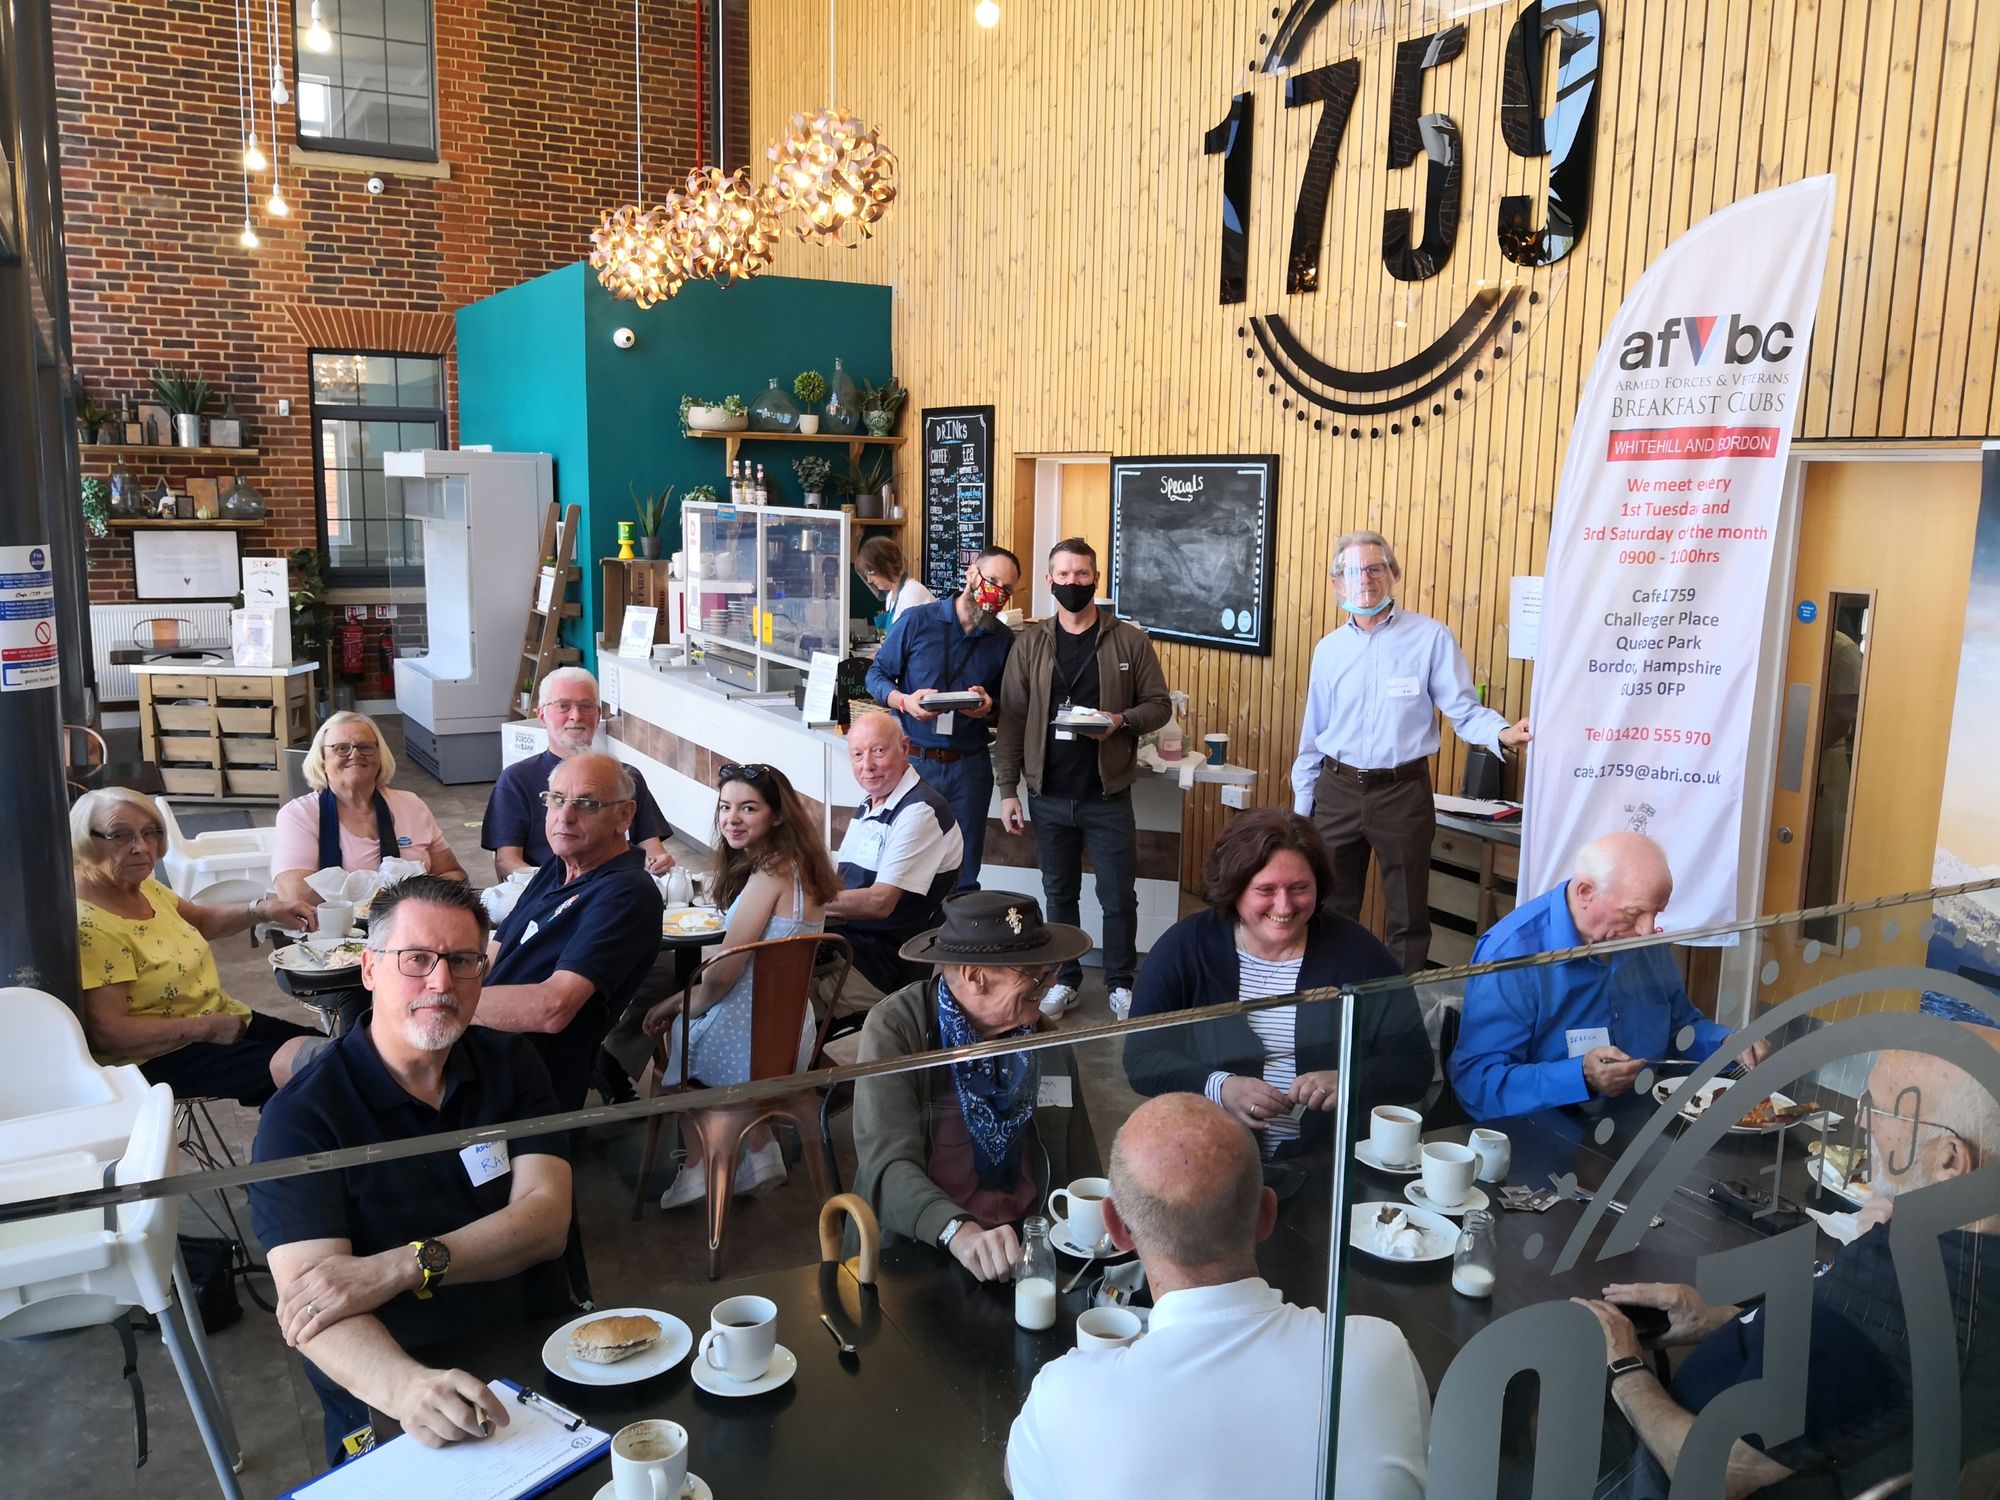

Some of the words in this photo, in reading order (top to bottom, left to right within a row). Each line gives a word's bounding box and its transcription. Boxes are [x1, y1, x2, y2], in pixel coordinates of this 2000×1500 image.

[1204, 0, 1601, 305] 1759
[1614, 378, 1660, 392] ARMED
[1665, 376, 1712, 389] FORCES
[1716, 374, 1727, 387] &
[1732, 372, 1790, 386] VETERANS
[1611, 395, 1721, 418] BREAKFAST
[1728, 391, 1786, 414] CLUBS
[1614, 439, 1683, 455] WHITEHILL
[1684, 437, 1715, 453] AND
[1718, 435, 1772, 451] BORDON
[1627, 478, 1650, 492] We
[1653, 478, 1692, 492] meet
[1621, 502, 1641, 517] 1st
[1702, 499, 1730, 514] and
[1583, 526, 1606, 541] 3rd
[1610, 526, 1674, 543] Saturday
[1690, 525, 1713, 540] the
[1717, 525, 1768, 540] month
[1619, 550, 1656, 565] 0900
[1632, 589, 1661, 603] Cafe
[1662, 588, 1696, 602] 1759
[1678, 611, 1720, 627] Place
[1667, 635, 1702, 650] Park
[1643, 659, 1722, 676] Hampshire
[1585, 727, 1604, 741] Tel
[1605, 727, 1650, 741] 01420
[1653, 728, 1681, 743] 555
[1685, 730, 1711, 746] 970
